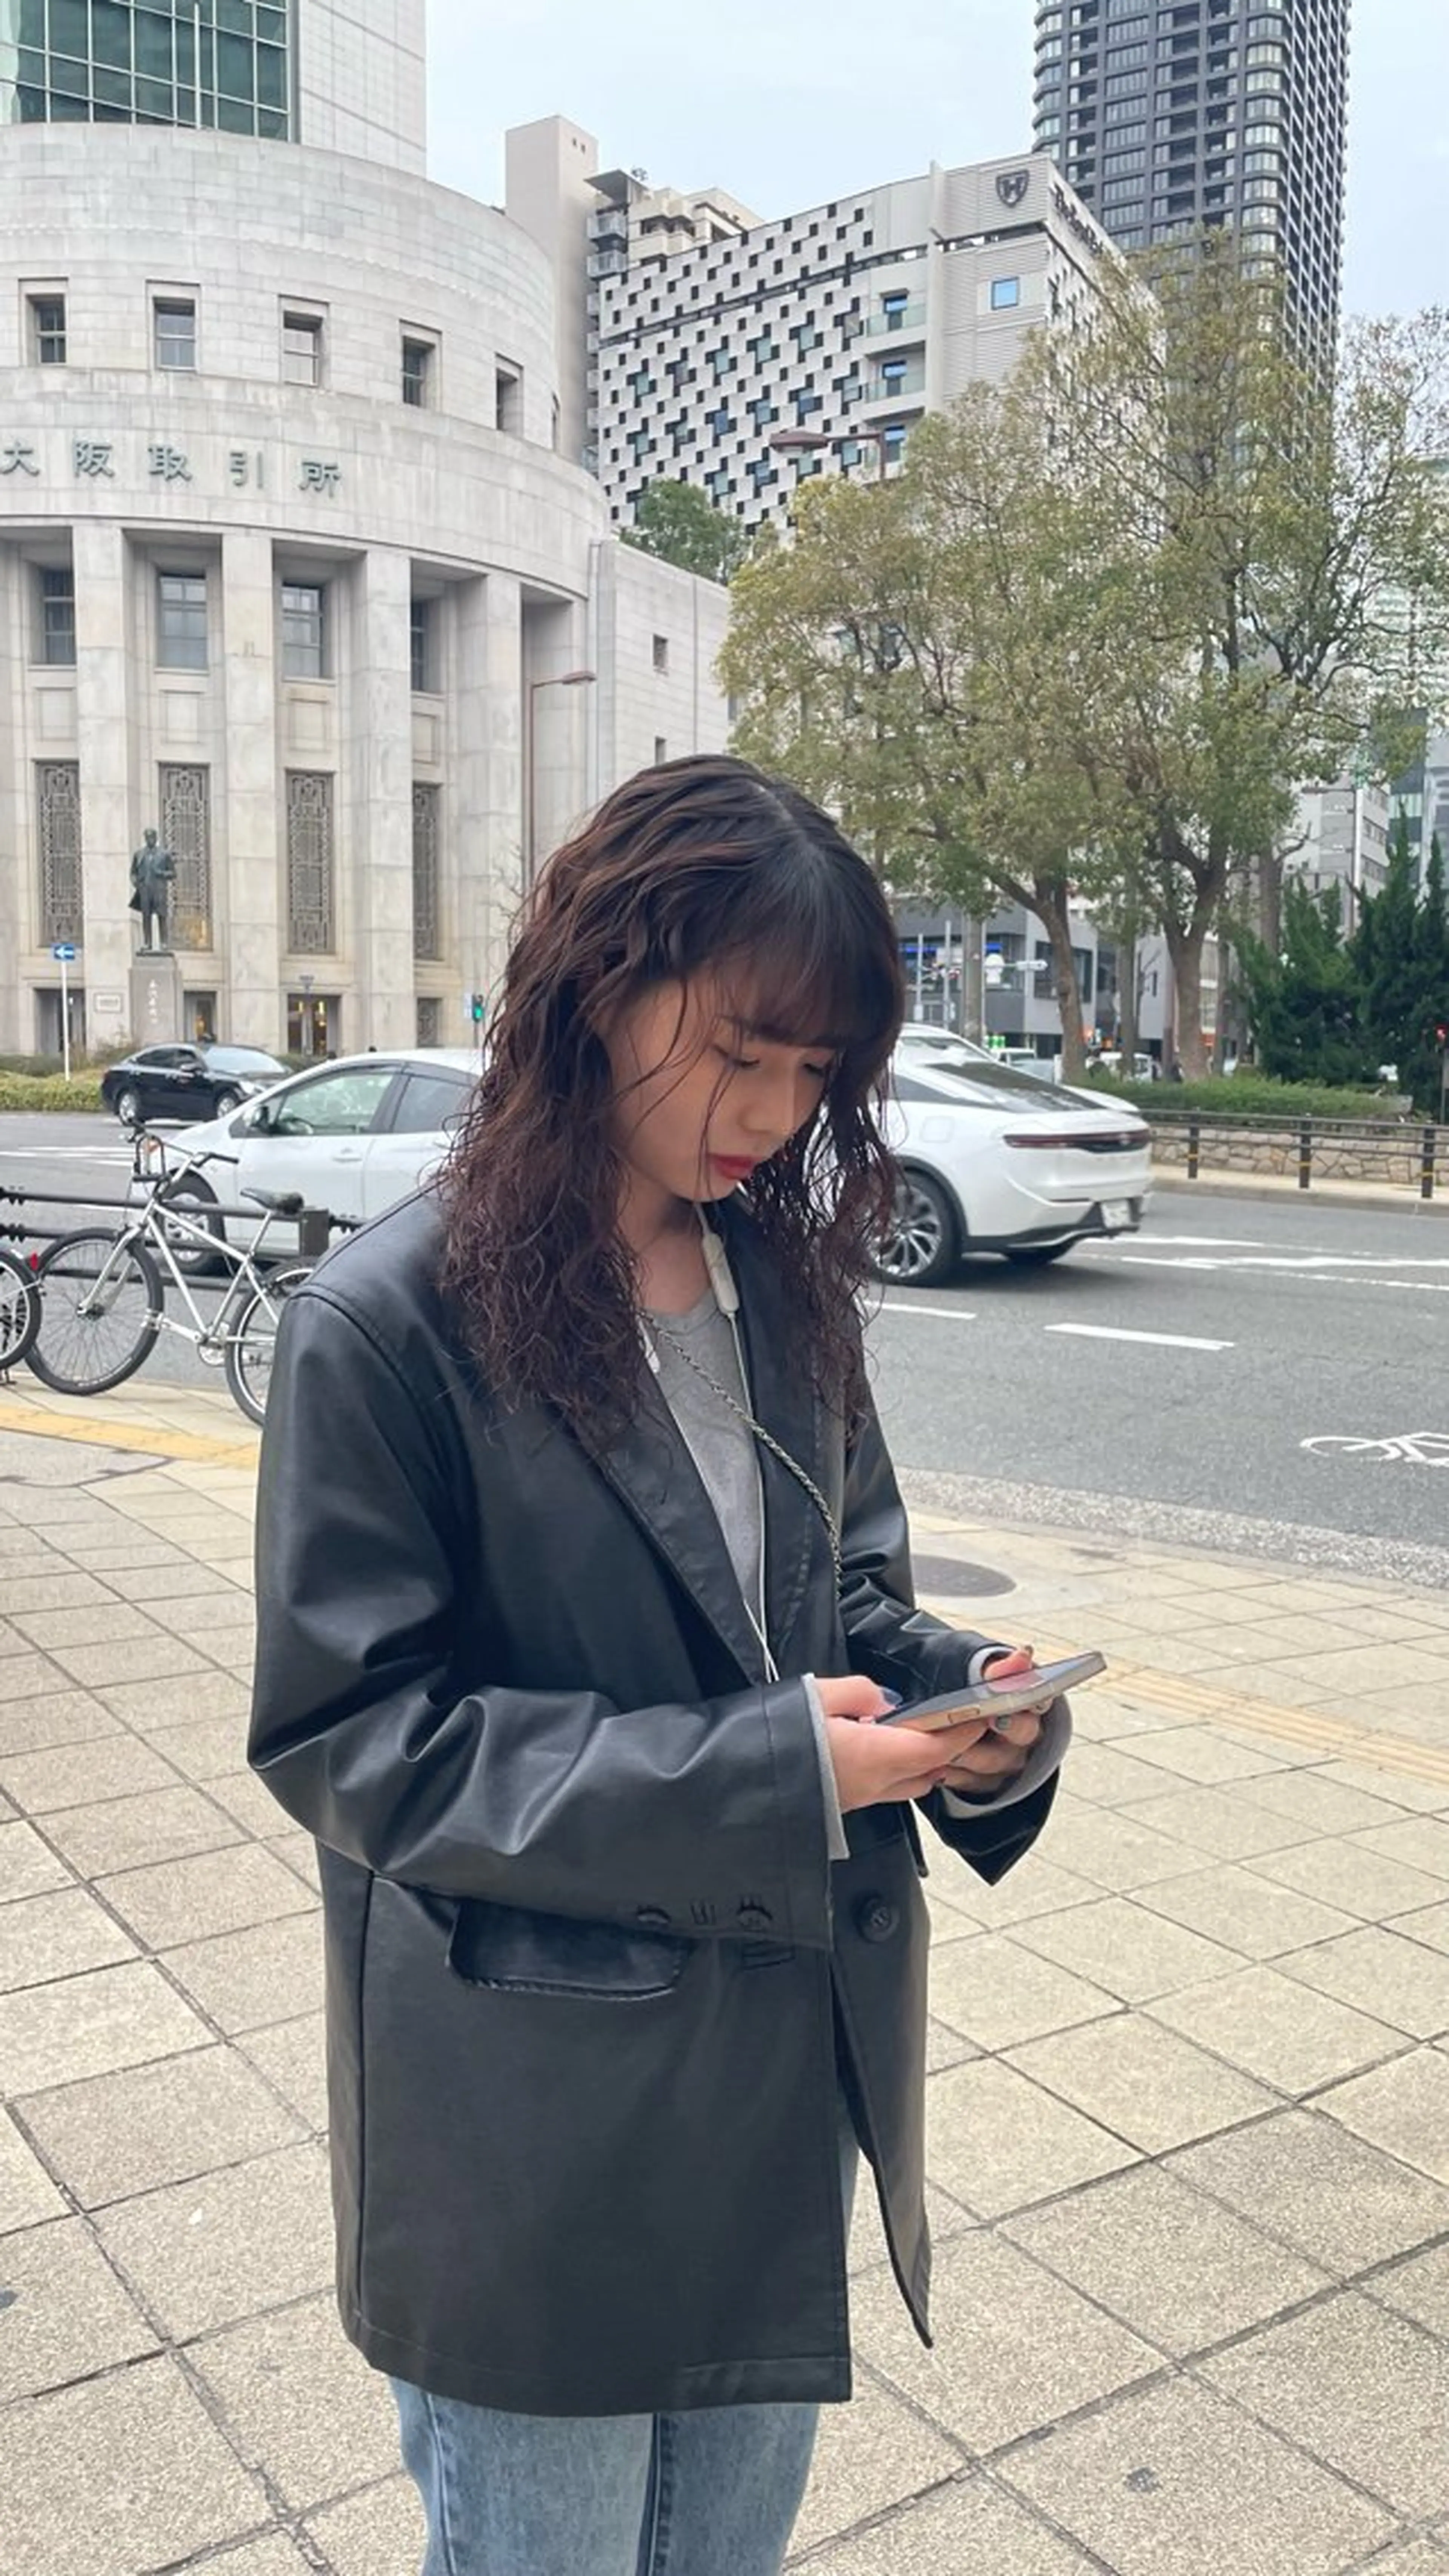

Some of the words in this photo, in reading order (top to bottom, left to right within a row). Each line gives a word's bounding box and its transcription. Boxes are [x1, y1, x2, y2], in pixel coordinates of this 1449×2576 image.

[0, 440, 341, 498] 大阪取引所
